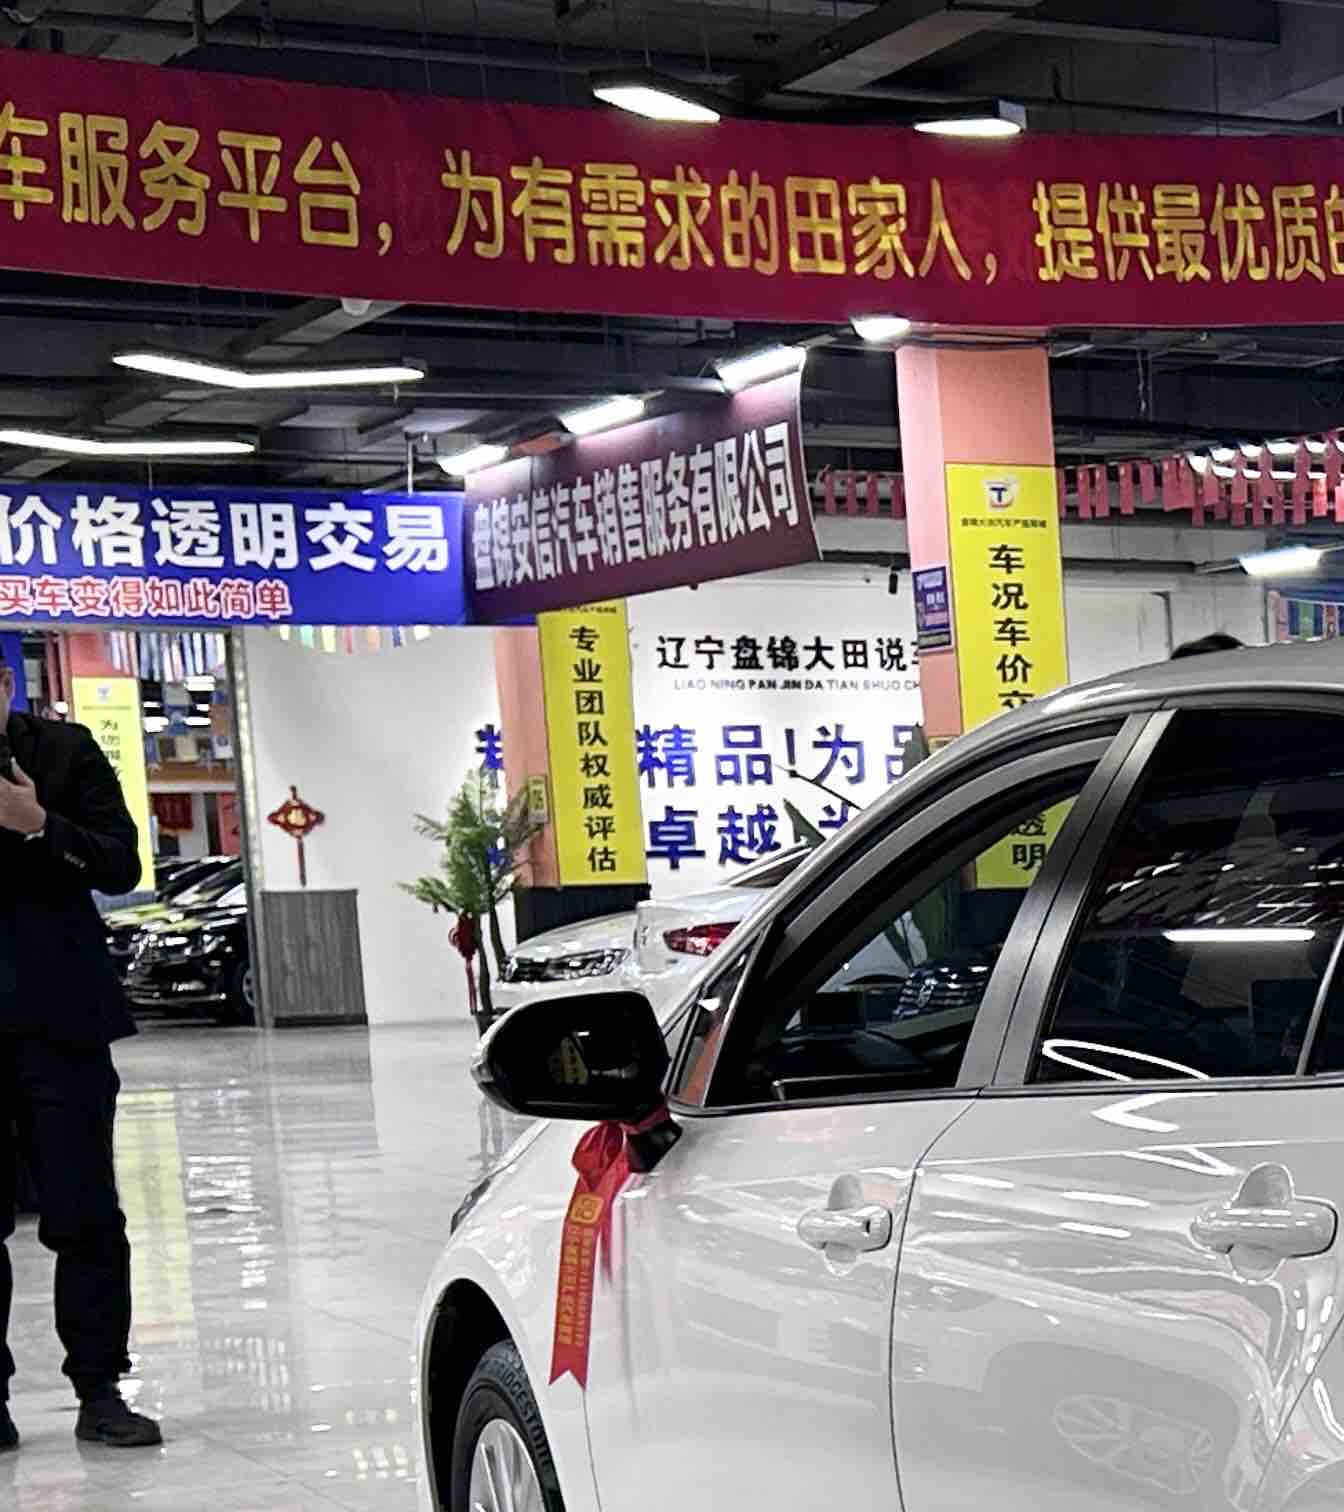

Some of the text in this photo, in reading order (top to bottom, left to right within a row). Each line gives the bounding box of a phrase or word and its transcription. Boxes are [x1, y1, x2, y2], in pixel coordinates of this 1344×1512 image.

[0, 574, 293, 619] 买车变得如此简单
[749, 680, 777, 690] PAN
[804, 680, 823, 690] DA
[569, 626, 617, 872] 专业团队权威评估
